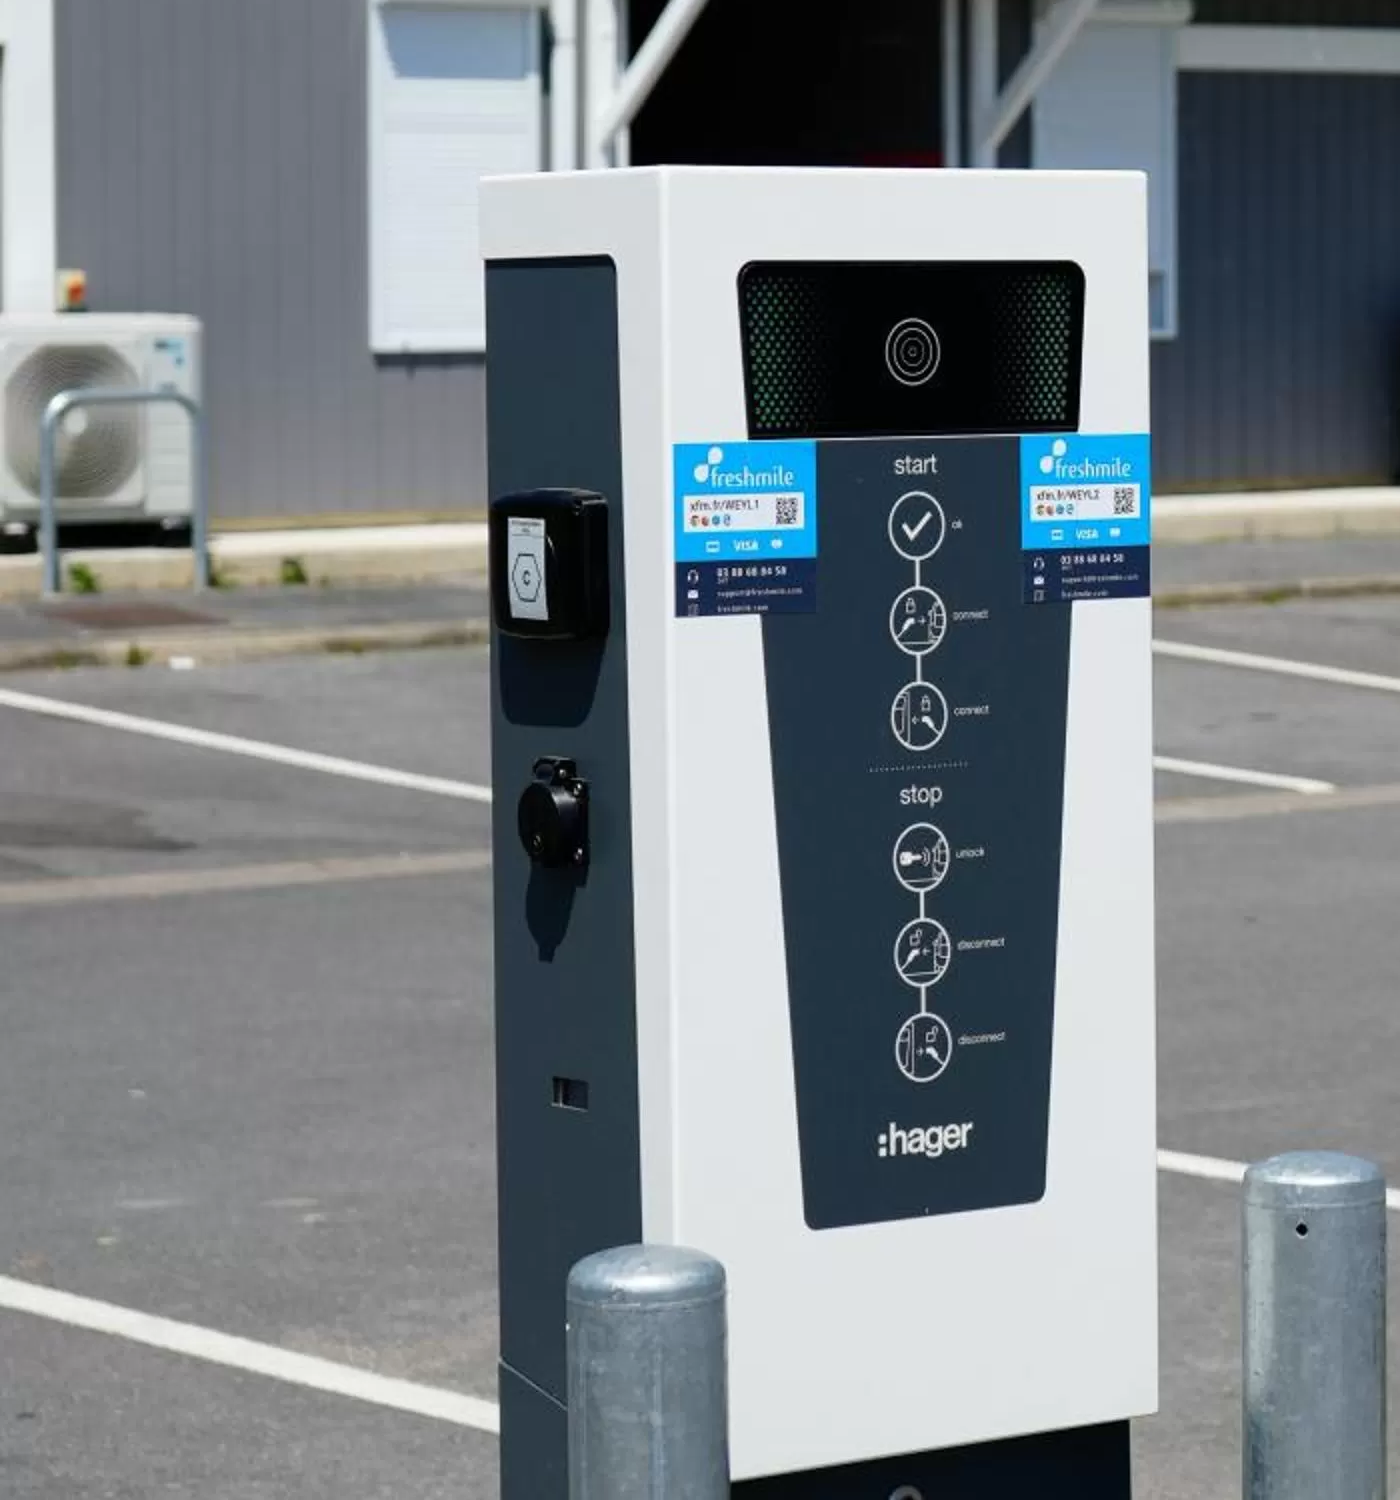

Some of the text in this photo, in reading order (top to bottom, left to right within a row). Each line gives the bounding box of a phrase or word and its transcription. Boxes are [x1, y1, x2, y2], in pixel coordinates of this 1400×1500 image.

[894, 454, 939, 475] start
[1055, 457, 1131, 479] freshmile
[711, 465, 795, 488] freshmile
[733, 539, 759, 551] VISA
[522, 569, 531, 586] C
[953, 704, 990, 717] connect
[900, 784, 943, 808] stop
